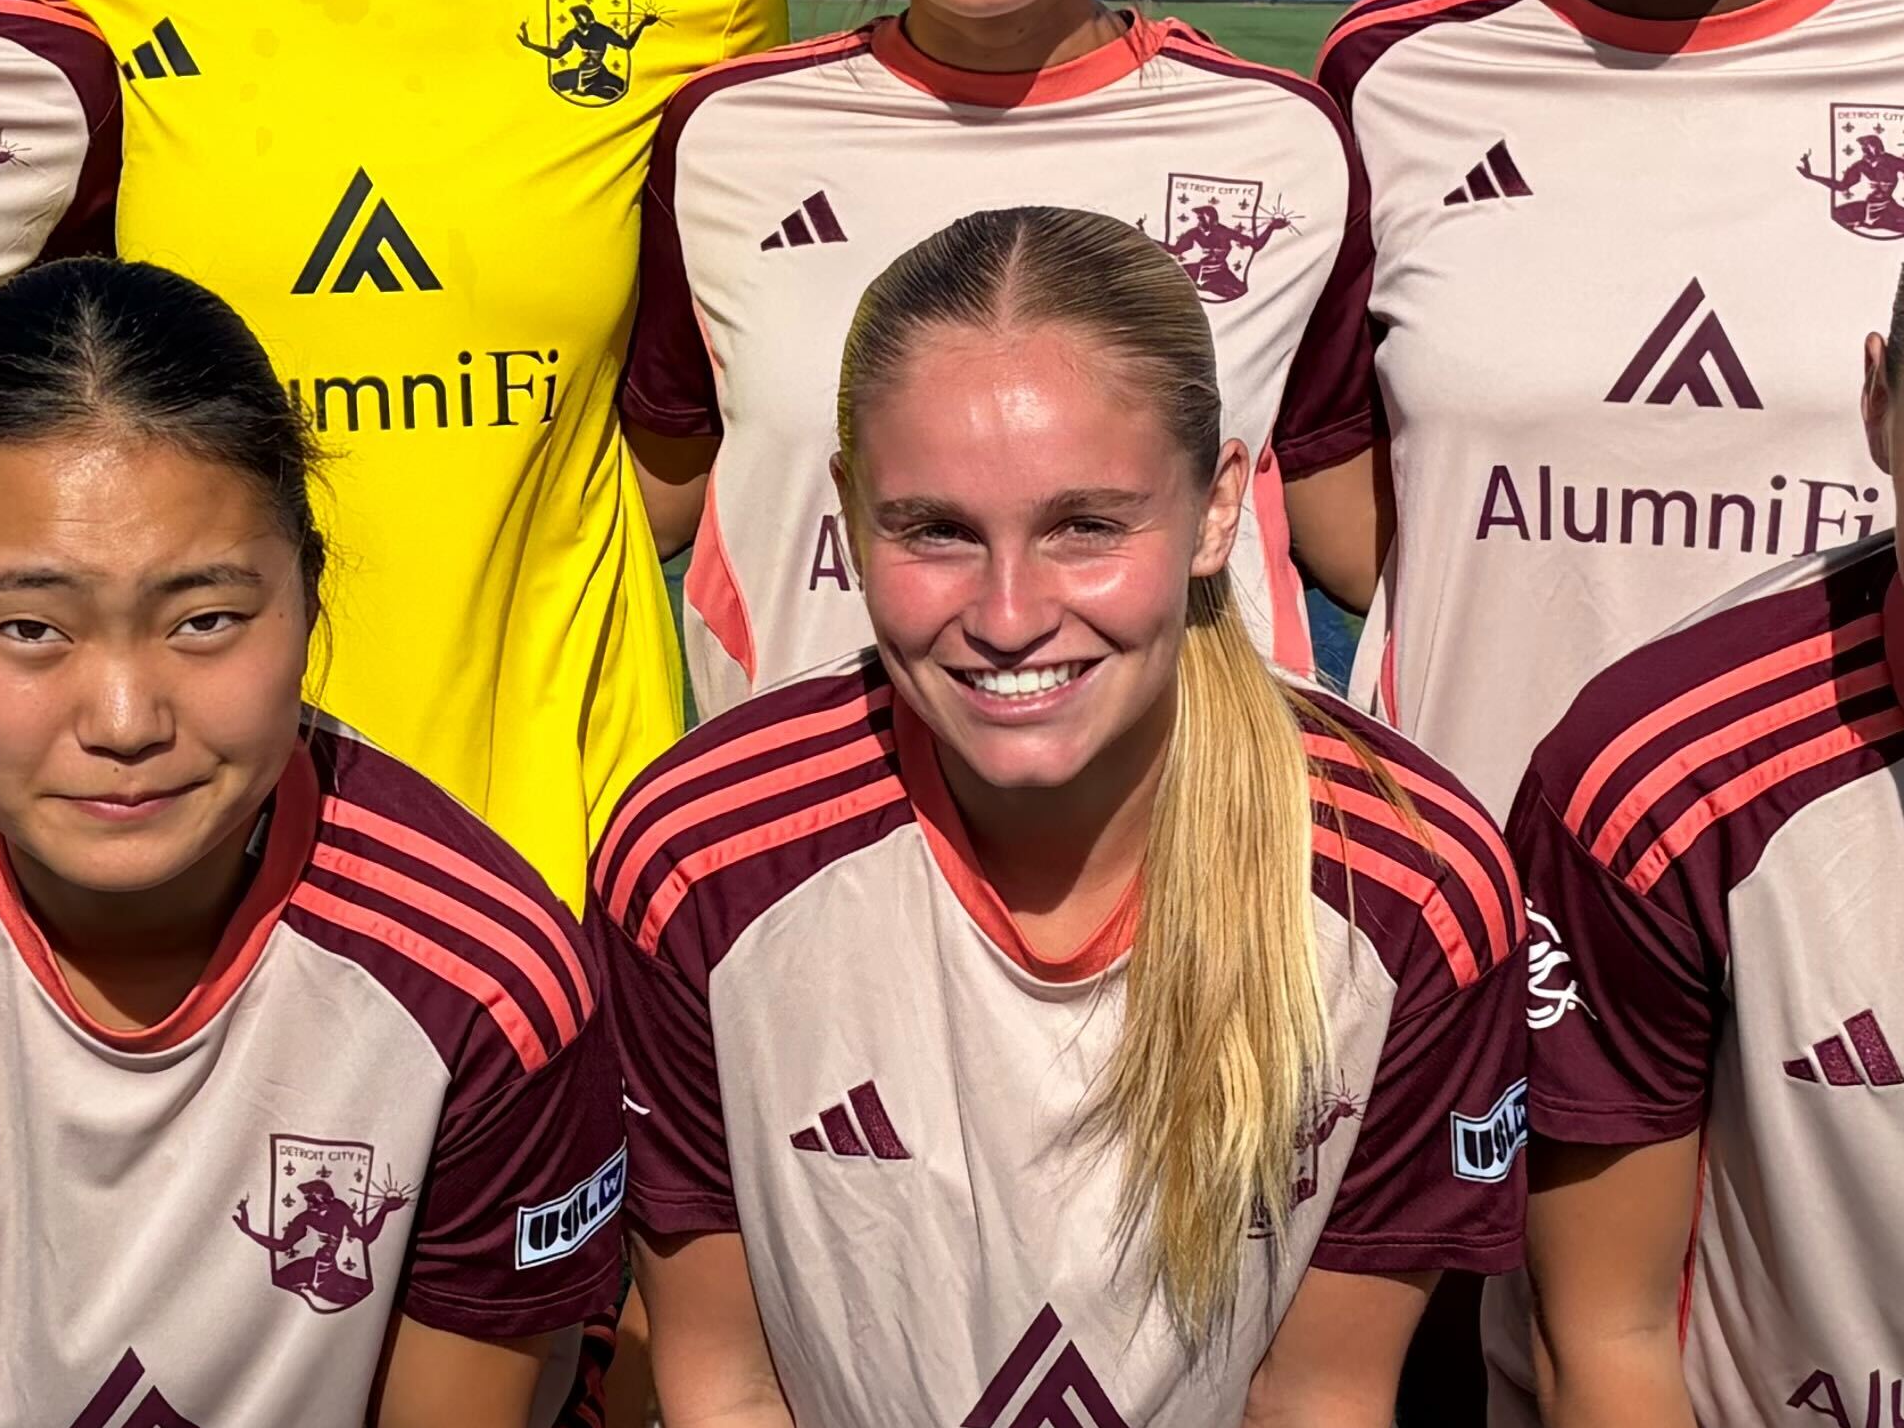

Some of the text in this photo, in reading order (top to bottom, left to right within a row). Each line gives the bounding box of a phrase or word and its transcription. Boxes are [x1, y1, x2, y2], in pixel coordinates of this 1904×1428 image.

[289, 350, 559, 433] mniFi
[1476, 465, 1880, 557] AlumniFi
[279, 1145, 325, 1161] DETROIT
[328, 1151, 355, 1161] CITY
